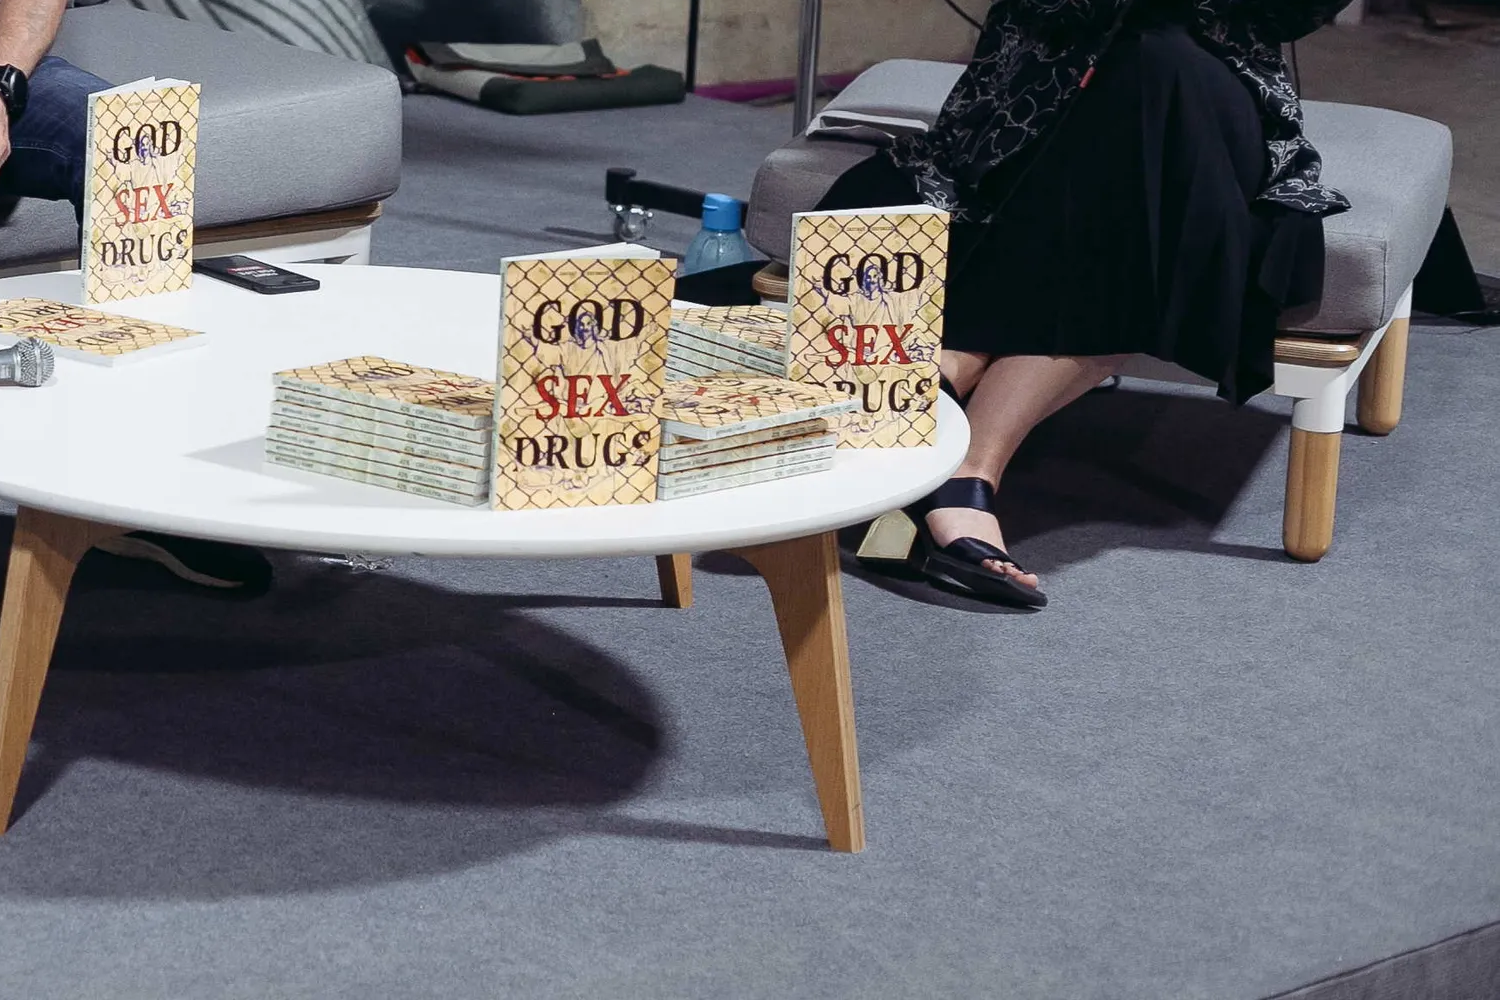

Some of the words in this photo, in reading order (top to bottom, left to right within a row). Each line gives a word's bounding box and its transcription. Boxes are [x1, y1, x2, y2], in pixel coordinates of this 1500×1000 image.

[113, 120, 182, 164] GOD
[115, 182, 175, 228] SEX
[100, 229, 188, 269] DRUGS
[822, 252, 924, 295] GOD
[533, 299, 645, 345] GOD
[825, 324, 914, 367] SEX
[536, 374, 632, 420] SEX
[514, 431, 652, 471] DRUGS
